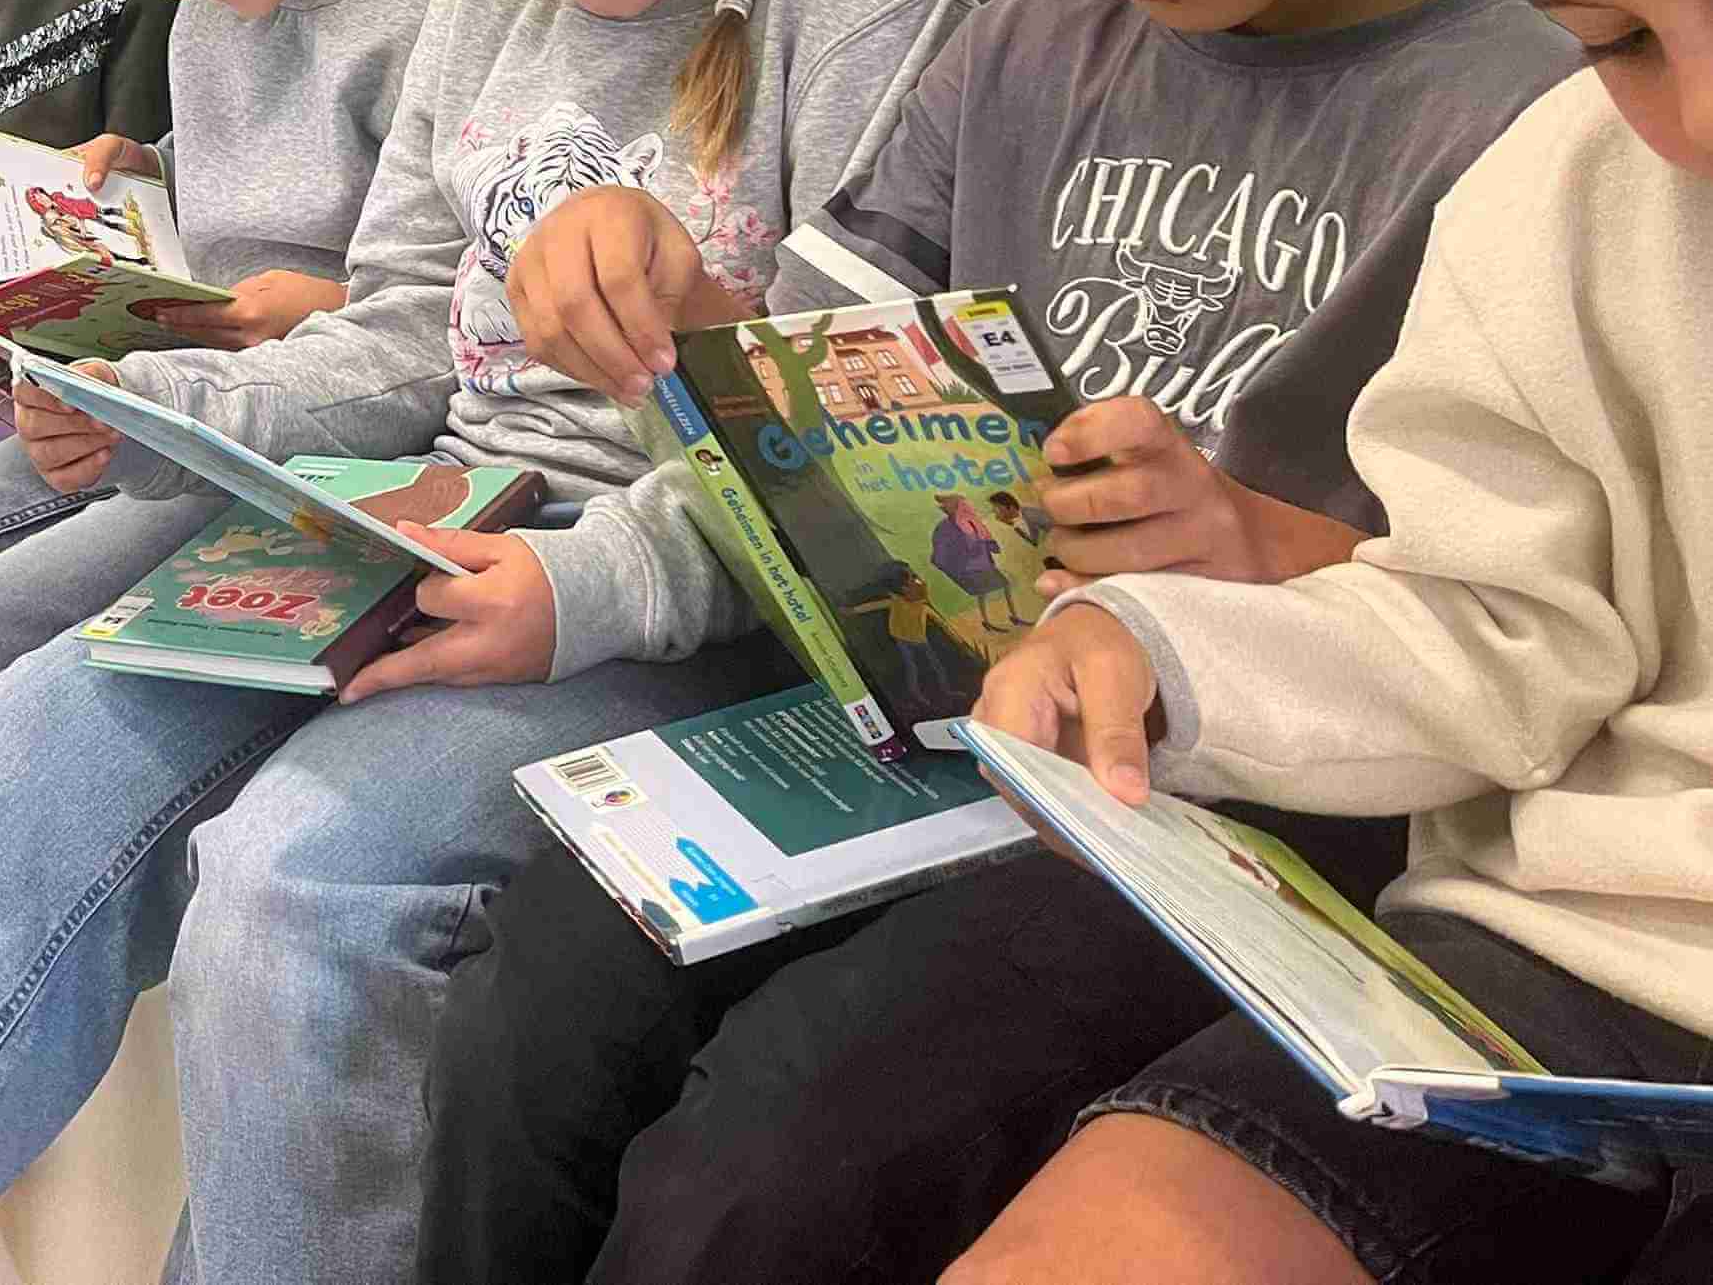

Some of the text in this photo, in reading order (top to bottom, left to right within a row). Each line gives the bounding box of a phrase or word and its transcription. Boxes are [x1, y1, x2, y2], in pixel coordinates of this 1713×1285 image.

[1051, 158, 1347, 314] CHICAGO
[757, 400, 1048, 470] Geheimen
[887, 446, 1032, 492] hotel
[721, 486, 764, 551] Geheimen
[784, 587, 813, 623] hotel
[175, 584, 320, 622] Zoet
